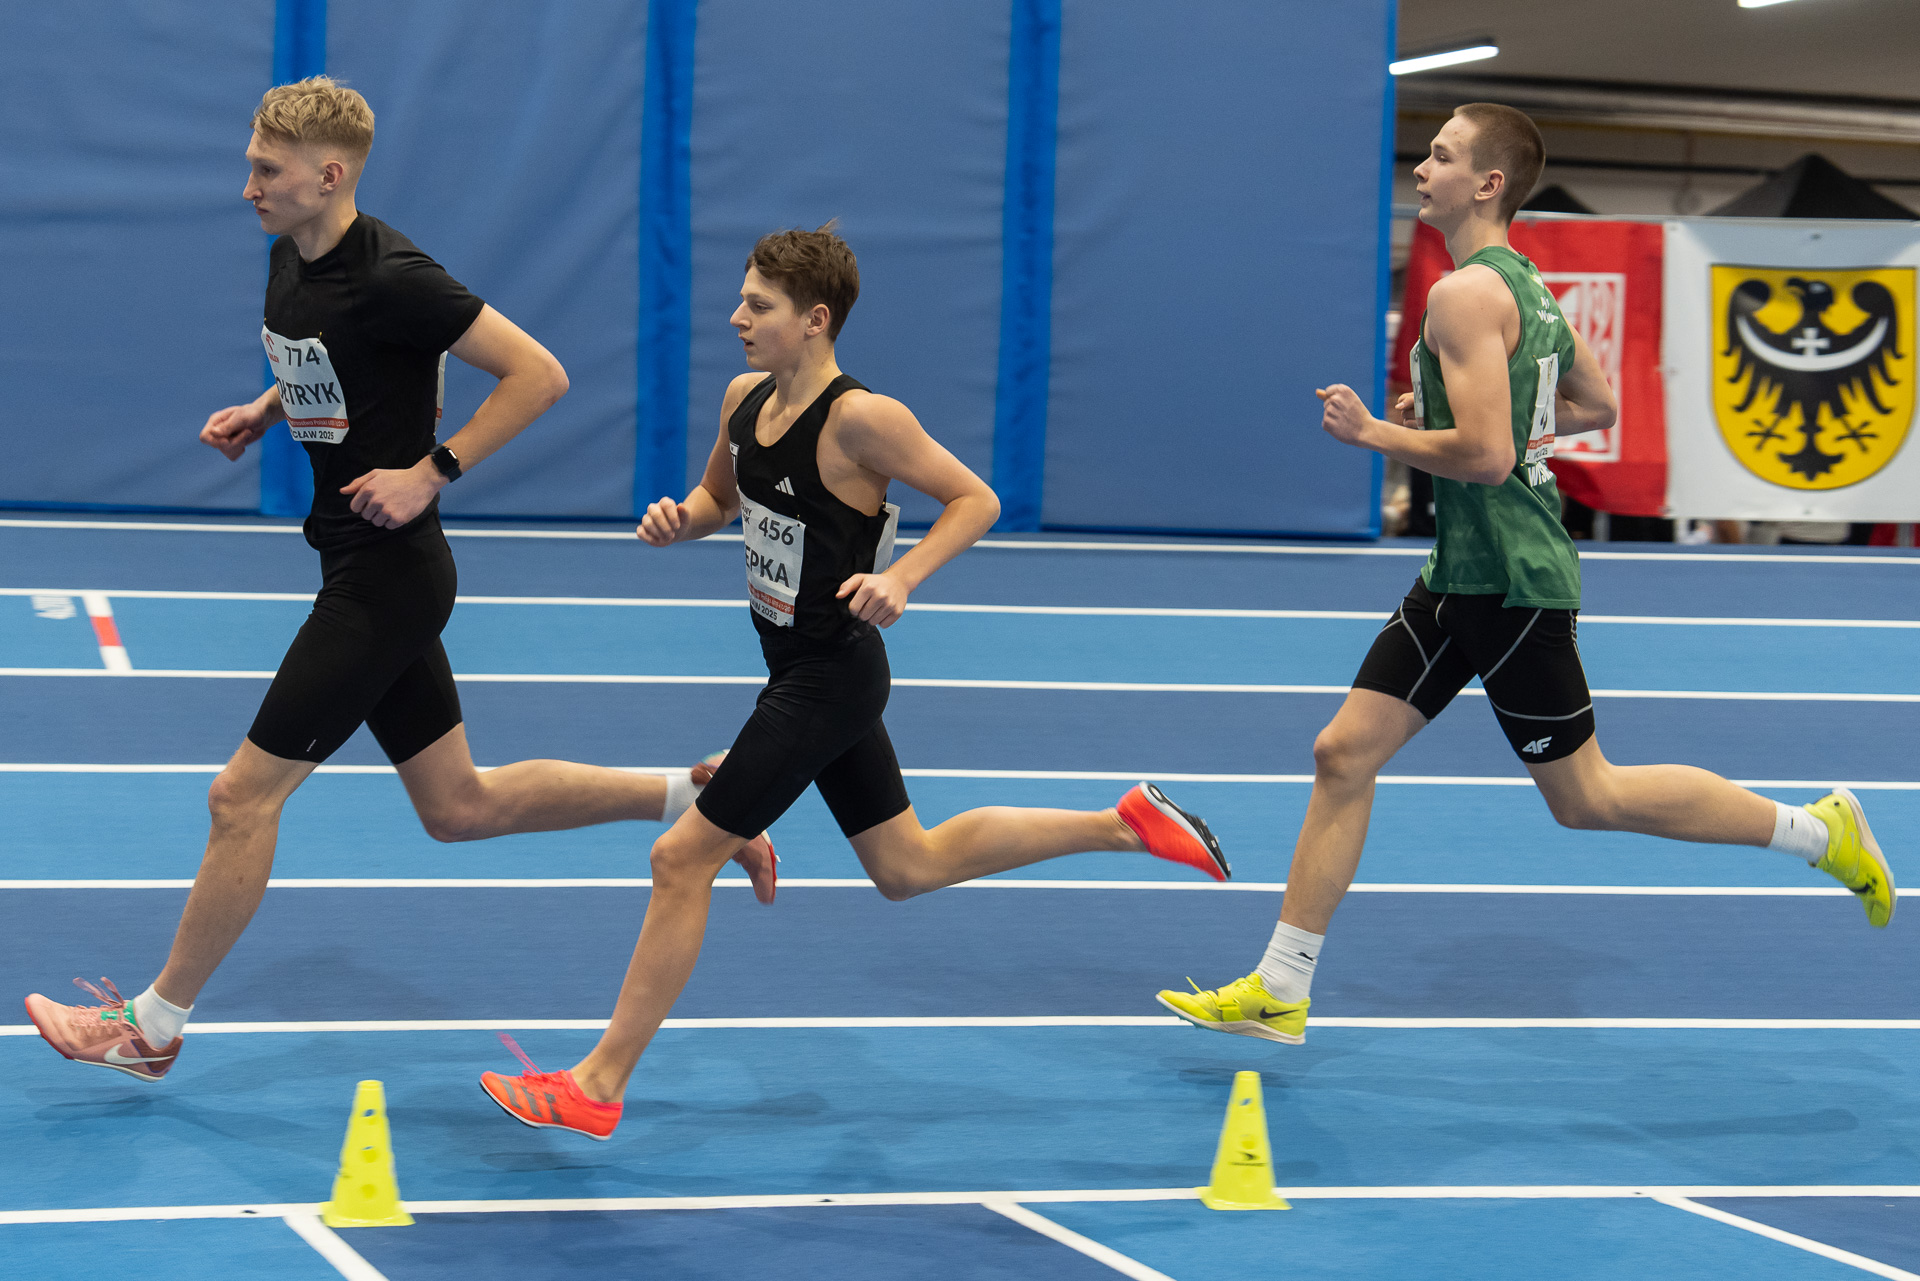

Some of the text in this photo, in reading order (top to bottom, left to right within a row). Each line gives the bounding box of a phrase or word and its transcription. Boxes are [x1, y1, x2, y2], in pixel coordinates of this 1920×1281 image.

[284, 345, 320, 367] 774
[318, 431, 335, 440] 2025
[758, 516, 794, 546] 456
[761, 605, 778, 621] 2025
[1522, 735, 1553, 755] 4F
